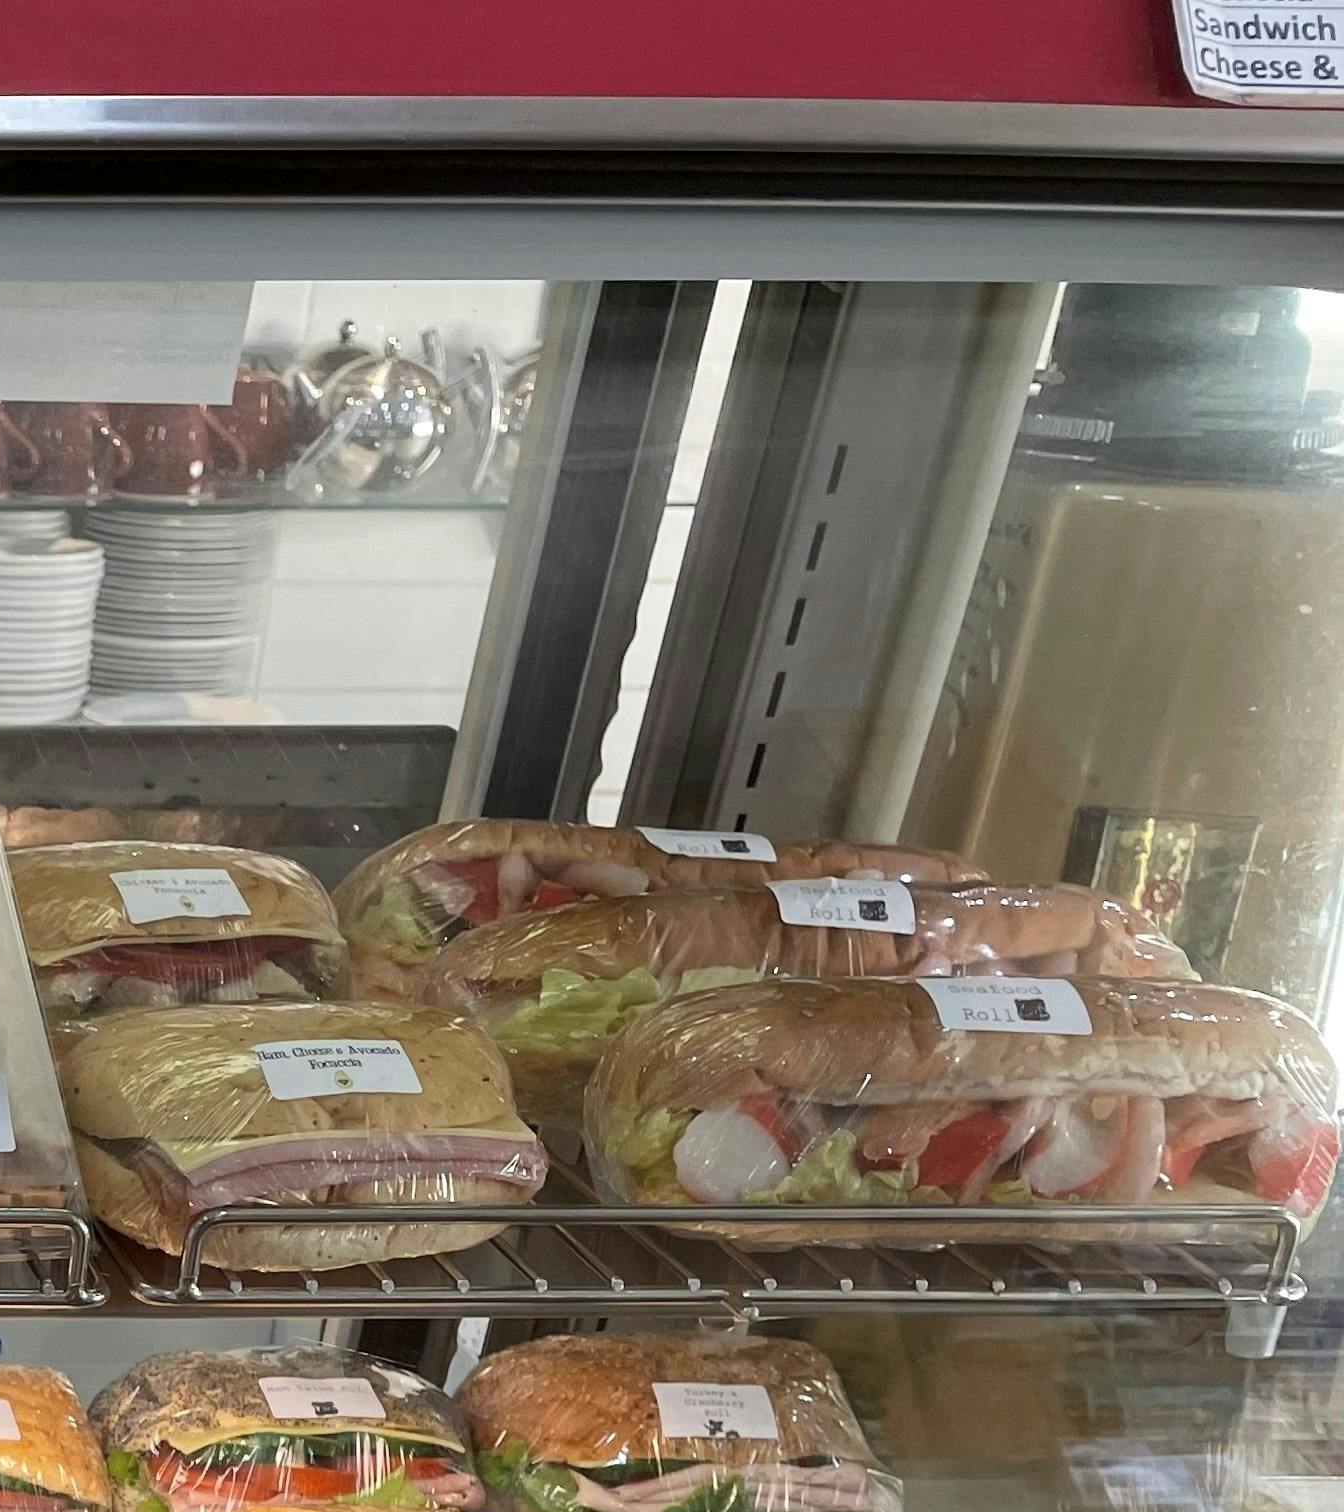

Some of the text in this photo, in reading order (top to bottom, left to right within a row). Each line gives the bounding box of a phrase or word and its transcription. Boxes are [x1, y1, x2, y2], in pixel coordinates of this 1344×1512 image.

[1194, 8, 1336, 41] Sandwich
[1200, 47, 1339, 80] Cheese &
[962, 1008, 1015, 1022] Roll
[348, 1045, 401, 1056] Avocado
[310, 1058, 362, 1070] Focaccia
